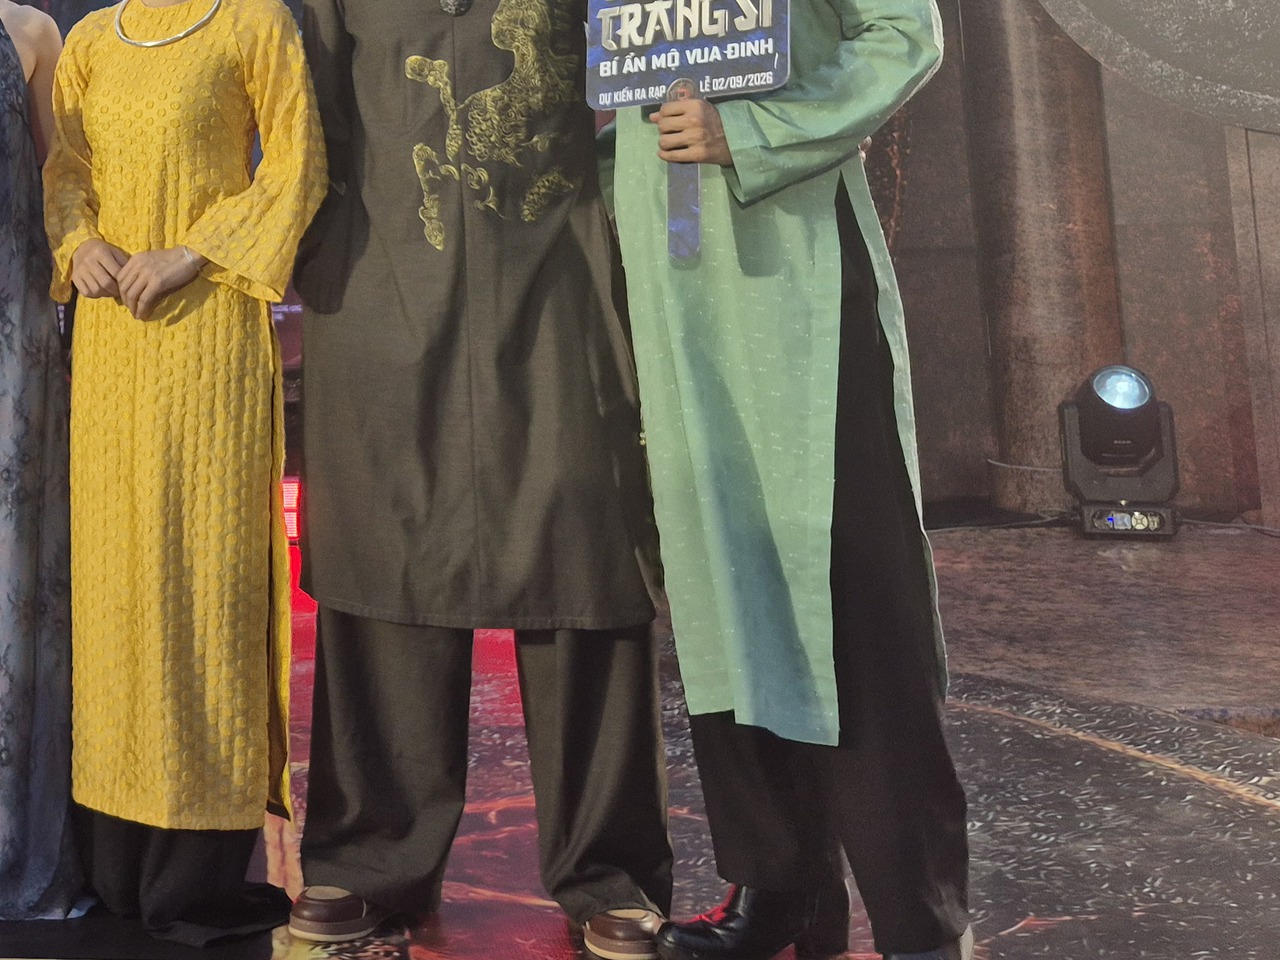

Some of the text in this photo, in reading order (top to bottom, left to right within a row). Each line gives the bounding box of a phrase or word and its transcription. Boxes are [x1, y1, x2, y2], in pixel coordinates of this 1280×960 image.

[600, 38, 773, 77] BÍ ẨN MỘ VUA ĐINH
[599, 93, 612, 106] DỰ
[635, 87, 647, 100] RA
[649, 84, 666, 103] RẠP
[712, 71, 773, 90] 02/09/2026
